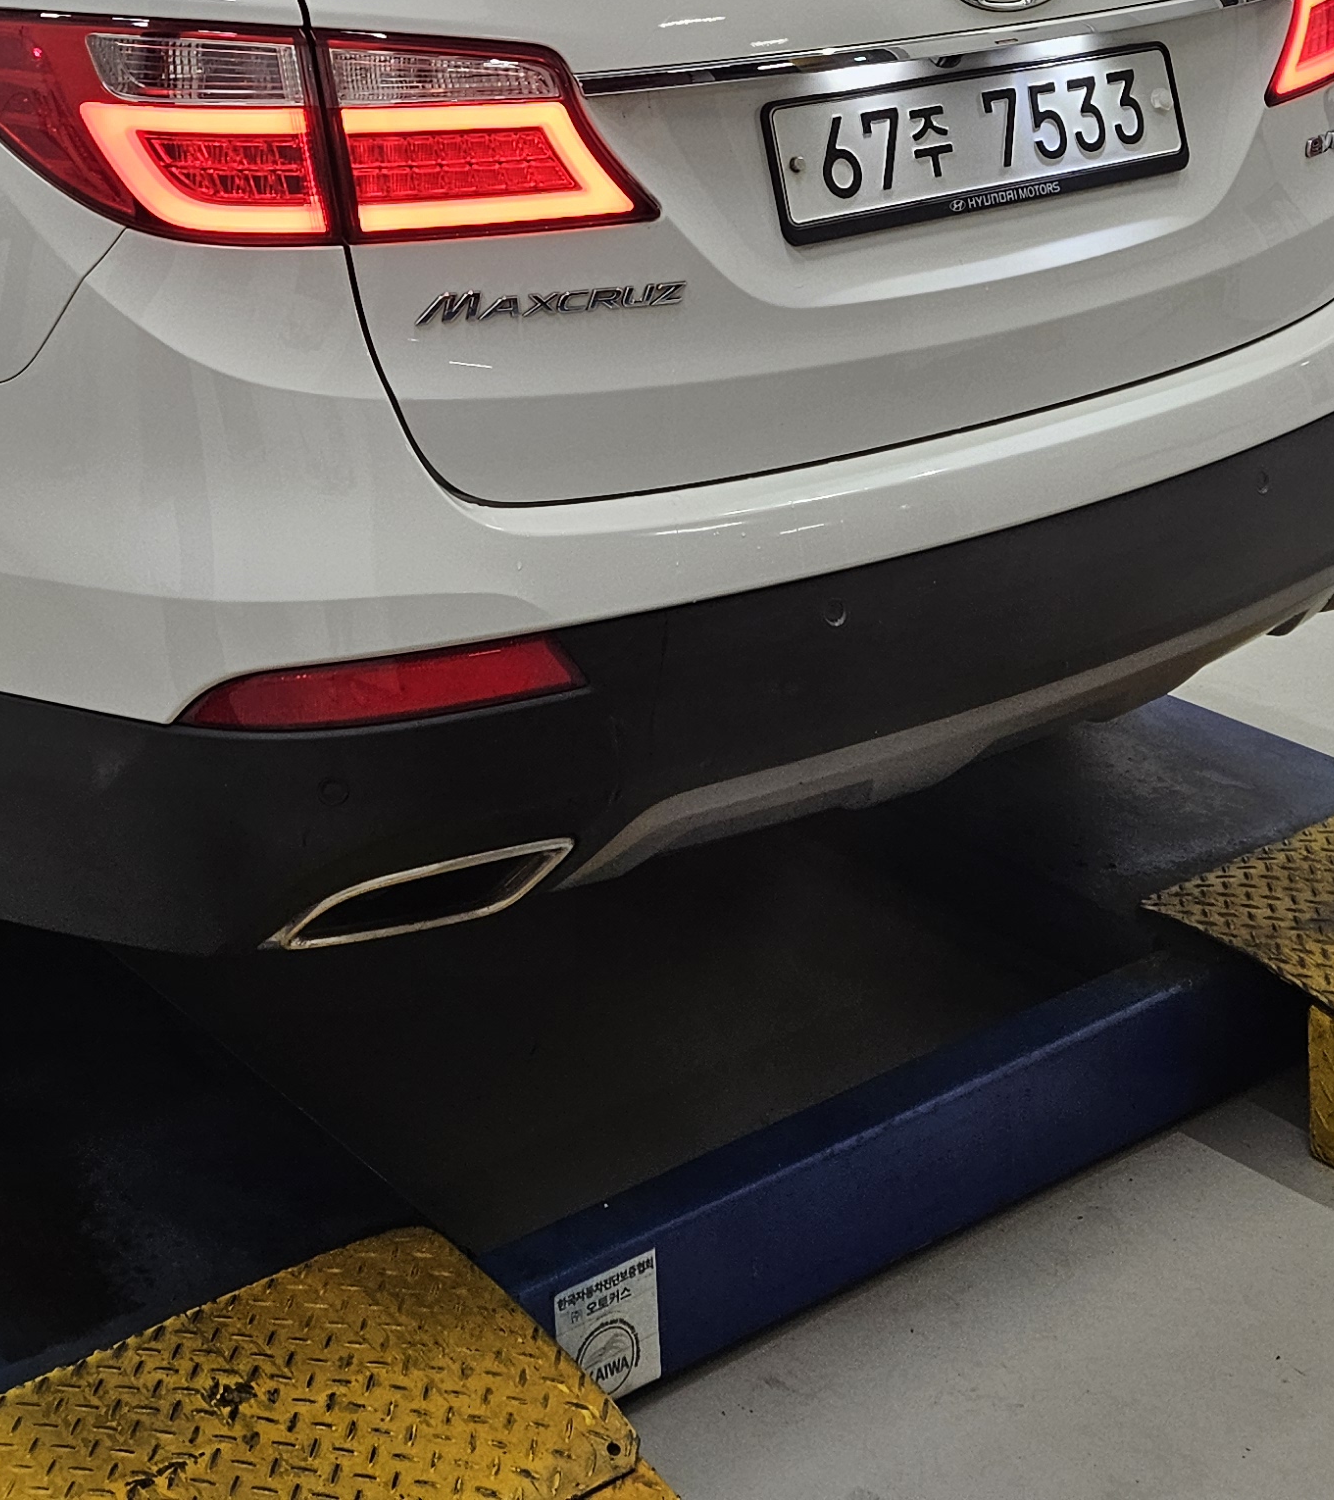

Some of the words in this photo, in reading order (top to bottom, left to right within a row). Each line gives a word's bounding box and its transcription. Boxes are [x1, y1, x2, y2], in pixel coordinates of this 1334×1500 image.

[822, 104, 954, 199] 67주
[981, 68, 1145, 168] 7533
[968, 190, 1018, 209] HYUNDAI
[1019, 181, 1061, 199] MOTORS
[415, 280, 687, 326] MAXCRUZ
[586, 1287, 632, 1316] 오토커스
[589, 1356, 630, 1383] AIWA
